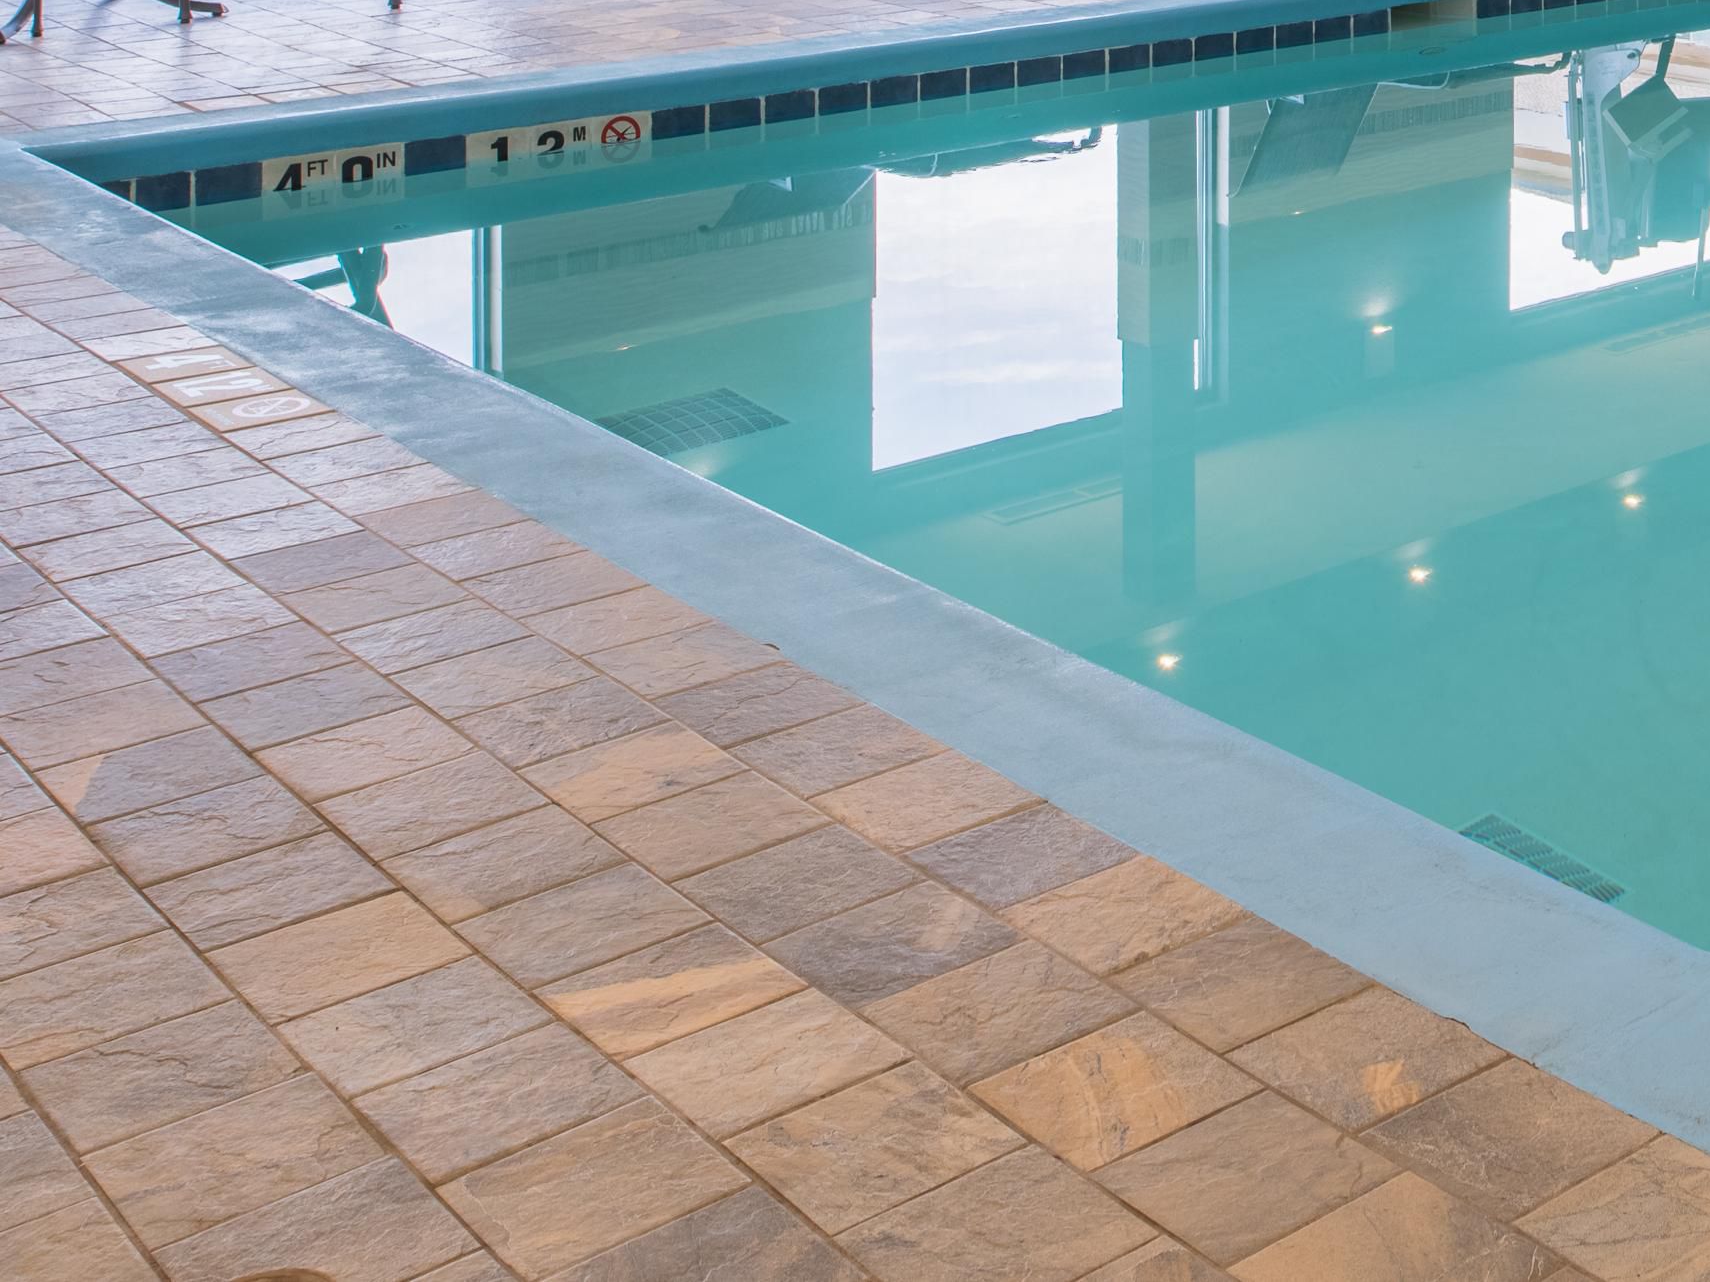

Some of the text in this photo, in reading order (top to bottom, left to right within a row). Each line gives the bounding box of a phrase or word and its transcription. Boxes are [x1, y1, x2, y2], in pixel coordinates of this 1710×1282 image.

[307, 159, 328, 177] FT
[376, 151, 396, 168] IN
[573, 126, 586, 142] M
